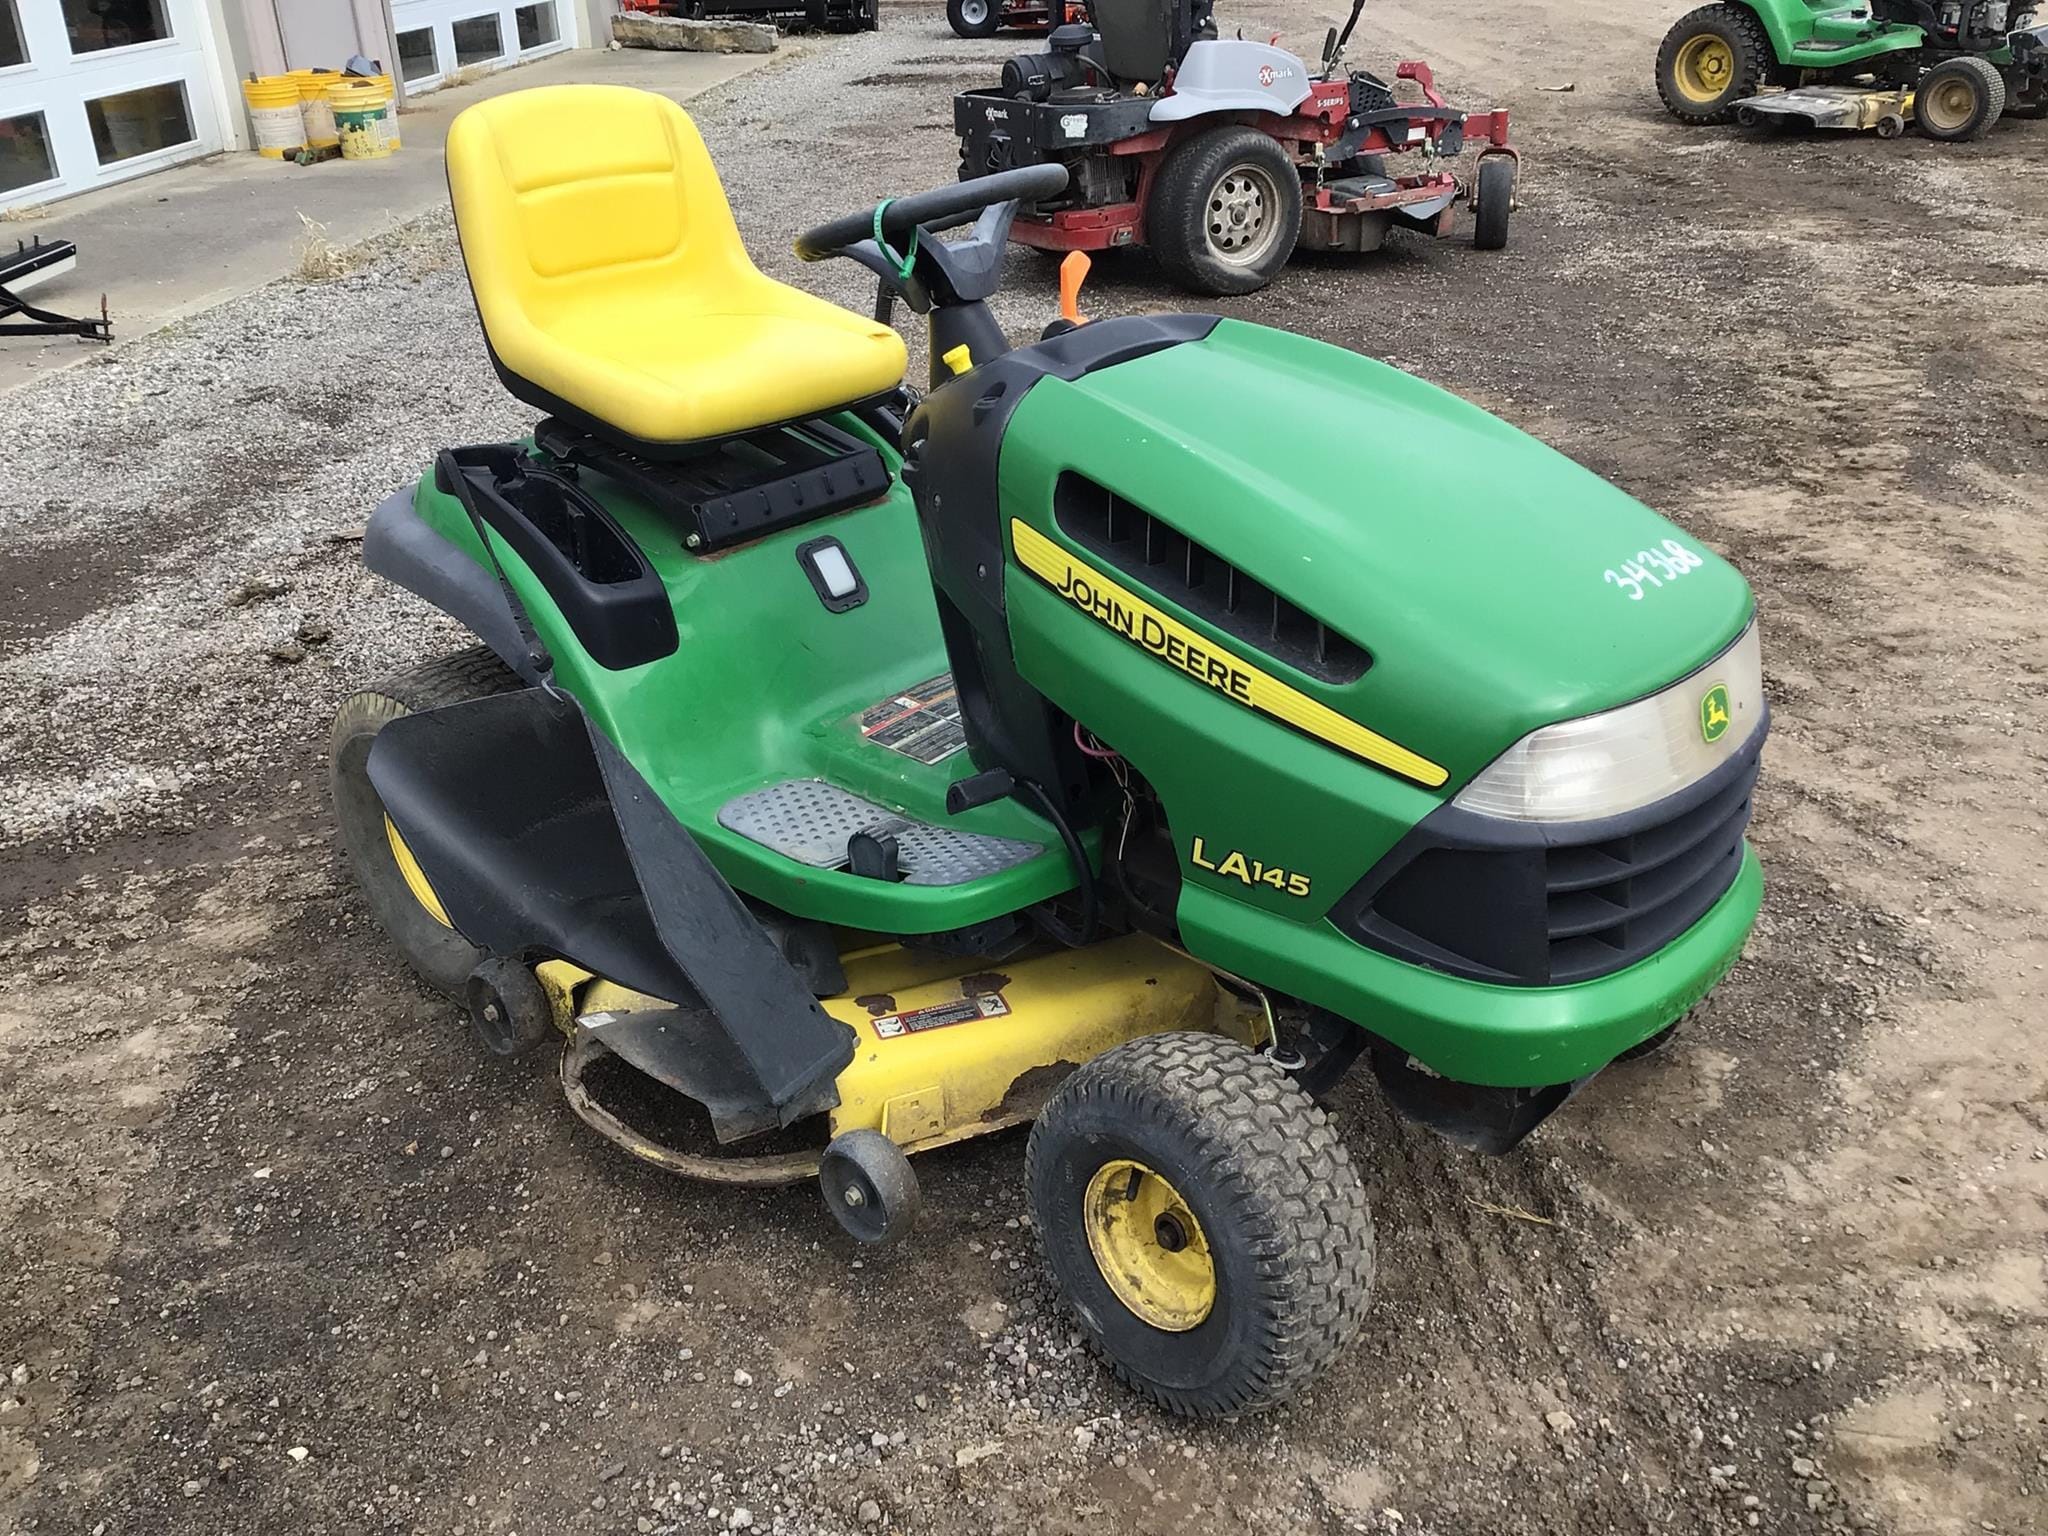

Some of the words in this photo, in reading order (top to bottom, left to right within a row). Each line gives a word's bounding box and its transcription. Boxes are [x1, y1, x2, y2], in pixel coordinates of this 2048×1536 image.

[1056, 566, 1135, 635] JOHN
[1141, 613, 1252, 701] DEERE
[1191, 836, 1312, 897] LA145
